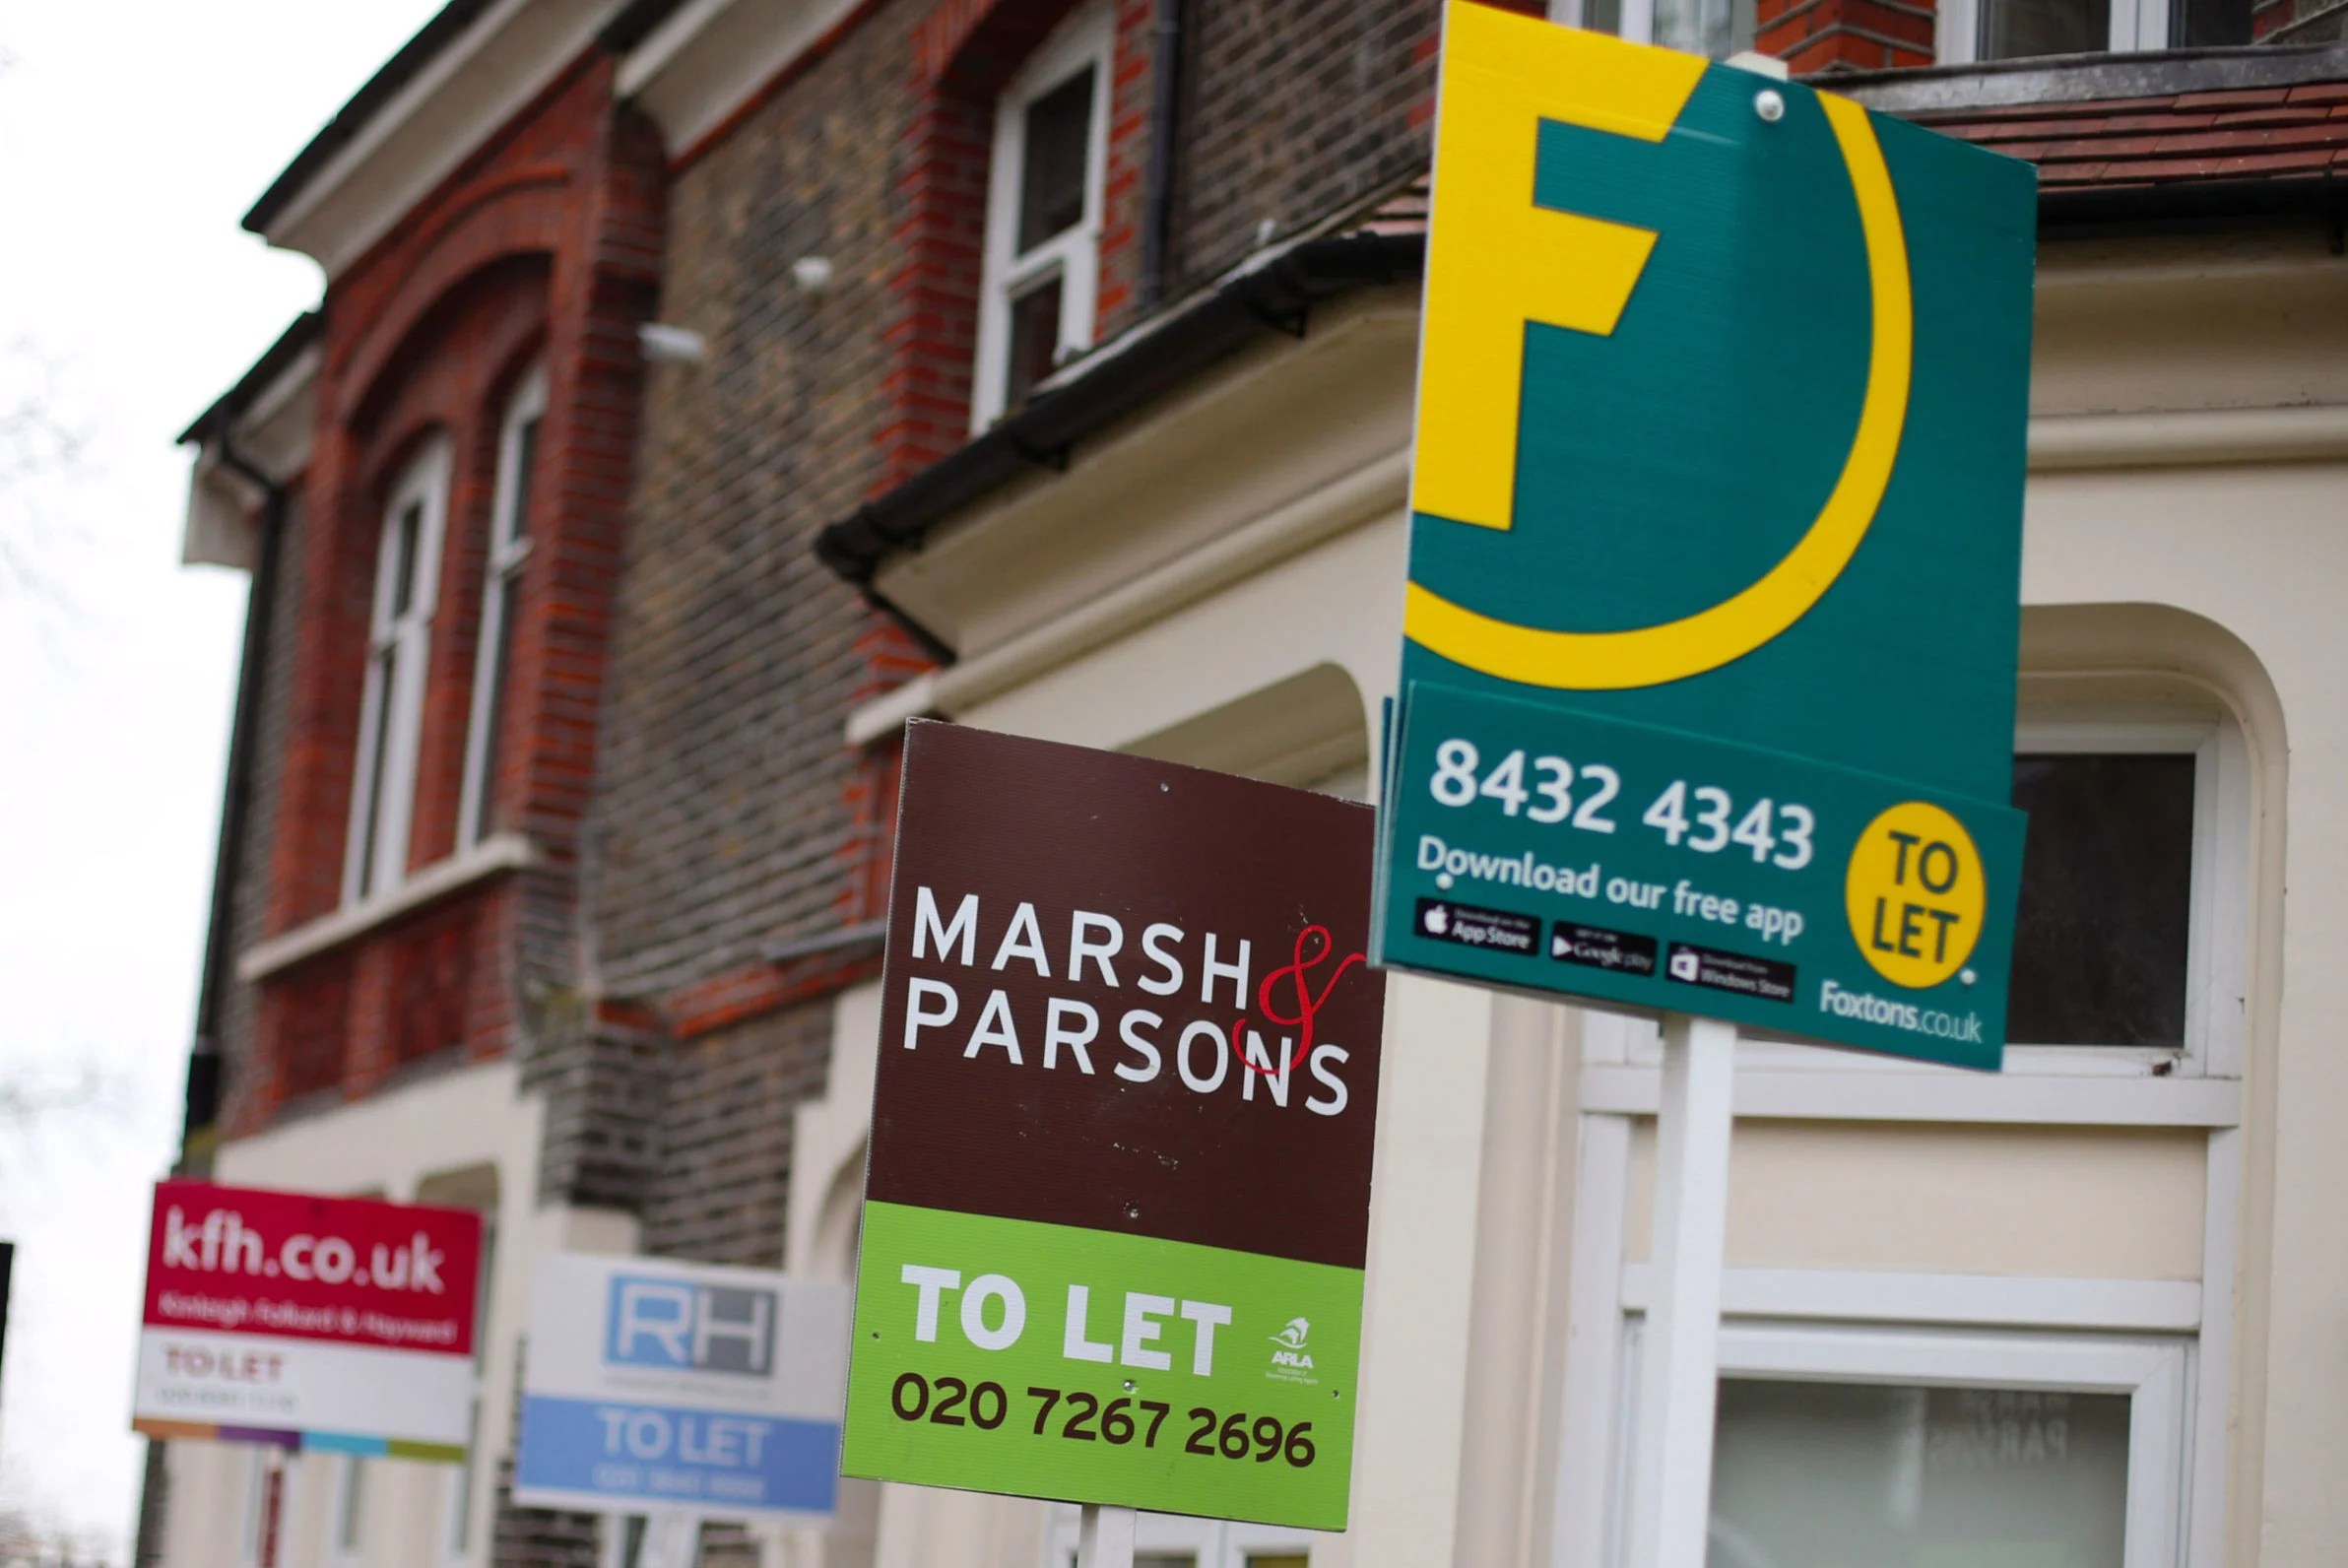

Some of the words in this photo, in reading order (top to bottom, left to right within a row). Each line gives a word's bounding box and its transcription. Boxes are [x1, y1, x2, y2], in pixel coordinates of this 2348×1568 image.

[1430, 739, 1621, 833] 8432
[1643, 780, 1815, 870] 4343
[1417, 836, 1599, 898] Download
[1606, 877, 1665, 911] our
[1673, 876, 1738, 925] free
[1745, 906, 1802, 946] app
[1888, 829, 1959, 895] TO
[1452, 921, 1486, 944] App
[1488, 926, 1531, 949] Store
[1574, 942, 1622, 966] Google
[1871, 896, 1960, 964] LET
[912, 886, 1251, 1010] MARSH
[1232, 925, 1367, 1075] &
[1820, 980, 1983, 1043] Foxtons.co.uk
[904, 977, 1350, 1116] PARSONS
[163, 1204, 445, 1294] kfh.co.uk
[617, 1282, 770, 1373] RH
[901, 1264, 1026, 1350] TO
[1063, 1284, 1232, 1377] LET
[1272, 1350, 1314, 1369] ARLA
[165, 1343, 215, 1379] TO
[219, 1348, 285, 1382] LET
[598, 1406, 672, 1461] TO
[678, 1415, 772, 1467] LET
[892, 1372, 1007, 1429] 020
[1026, 1387, 1170, 1448] 7267
[1185, 1407, 1315, 1468] 2696
